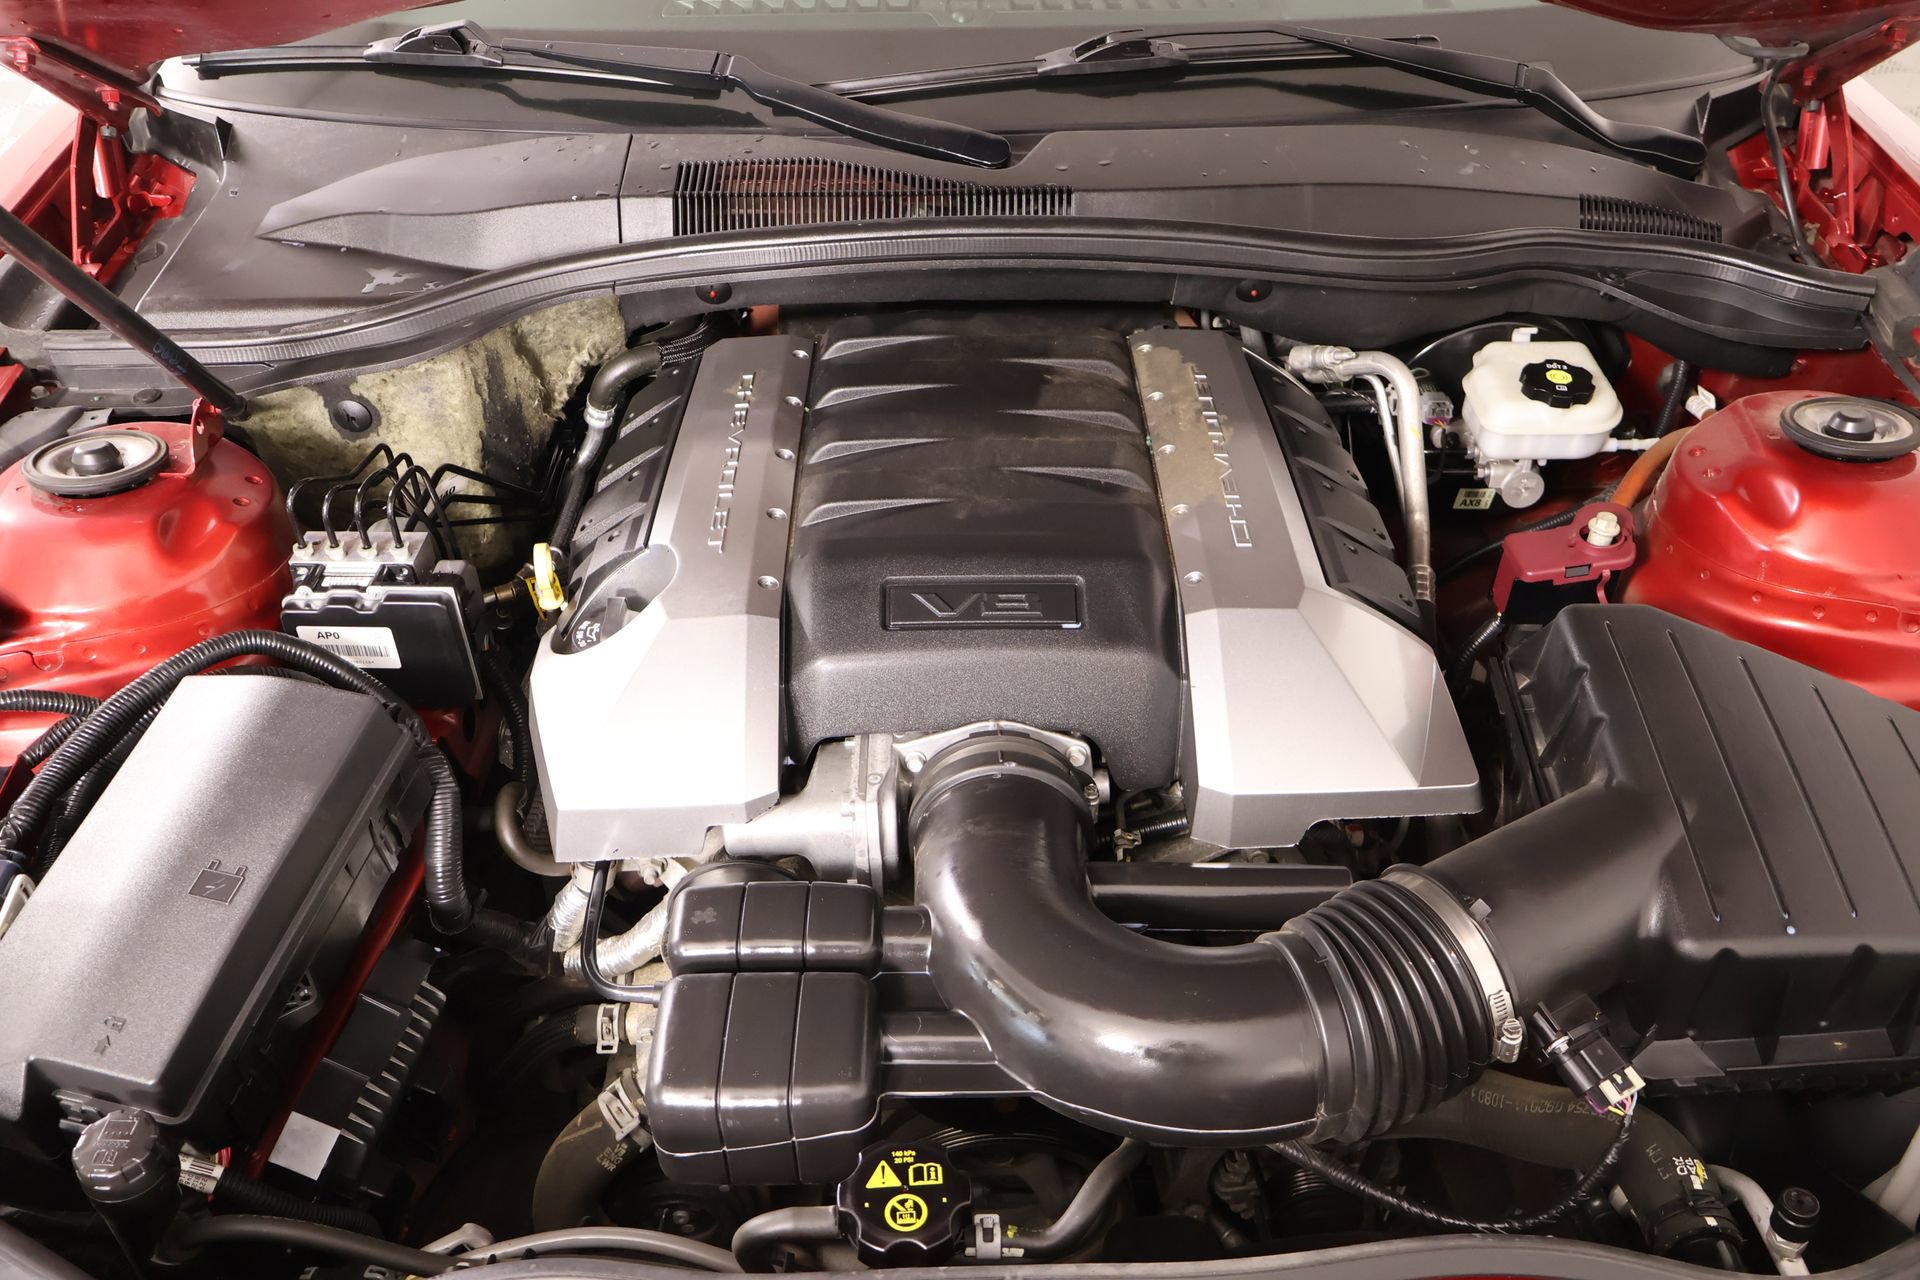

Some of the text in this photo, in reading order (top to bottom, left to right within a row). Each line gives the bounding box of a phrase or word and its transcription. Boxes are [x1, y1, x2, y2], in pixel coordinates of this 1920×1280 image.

[707, 372, 756, 554] CHEVROLET
[1191, 366, 1253, 547] CHEVROLET
[911, 592, 1043, 617] V8
